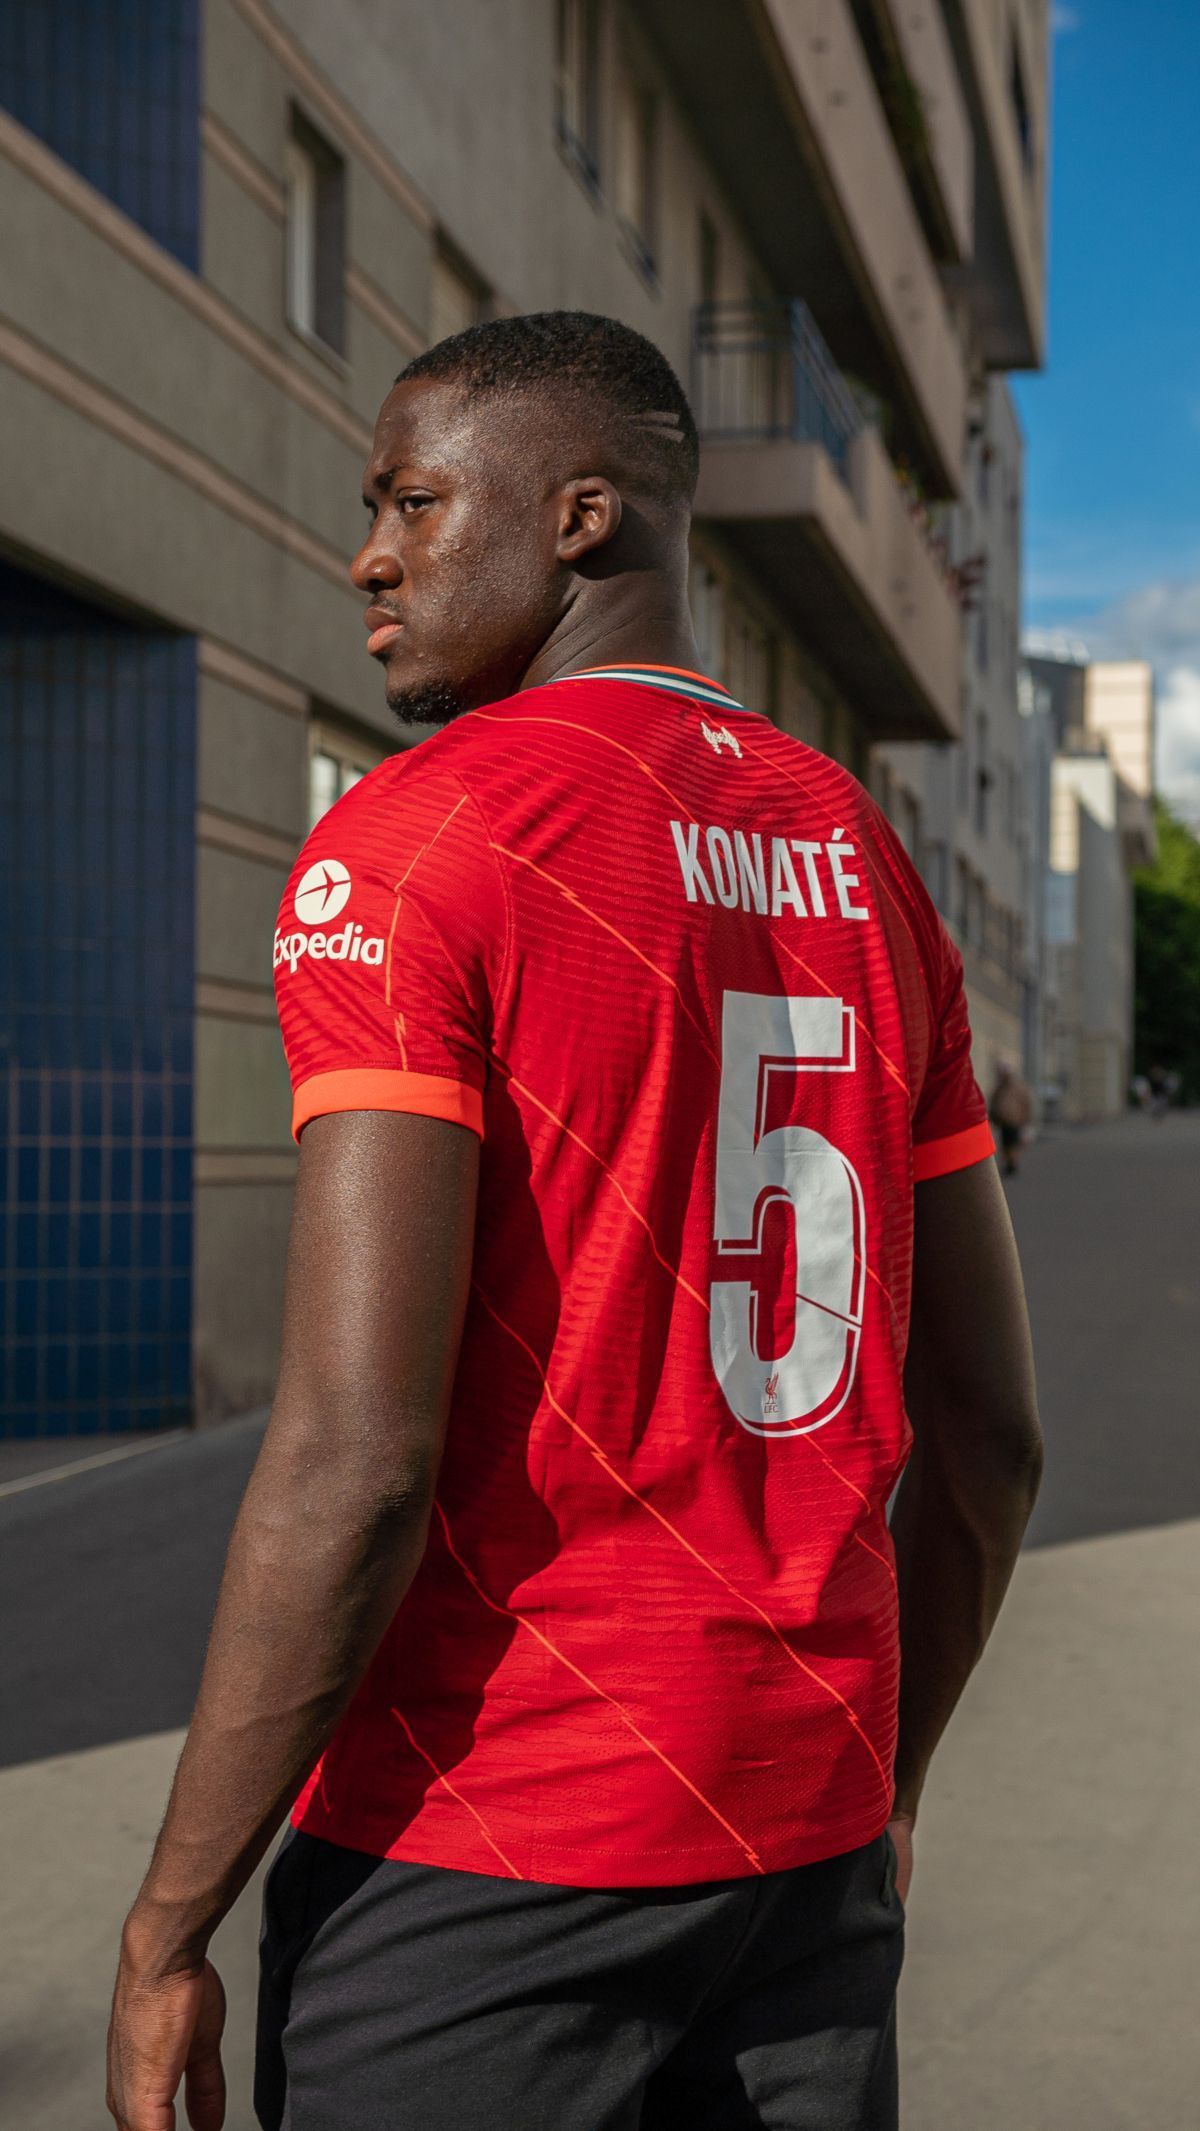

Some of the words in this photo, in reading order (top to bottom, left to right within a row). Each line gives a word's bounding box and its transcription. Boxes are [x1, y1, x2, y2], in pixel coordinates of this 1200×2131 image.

[670, 820, 869, 920] KONATÉ
[709, 989, 866, 1438] 5
[764, 1404, 779, 1413] LFC
